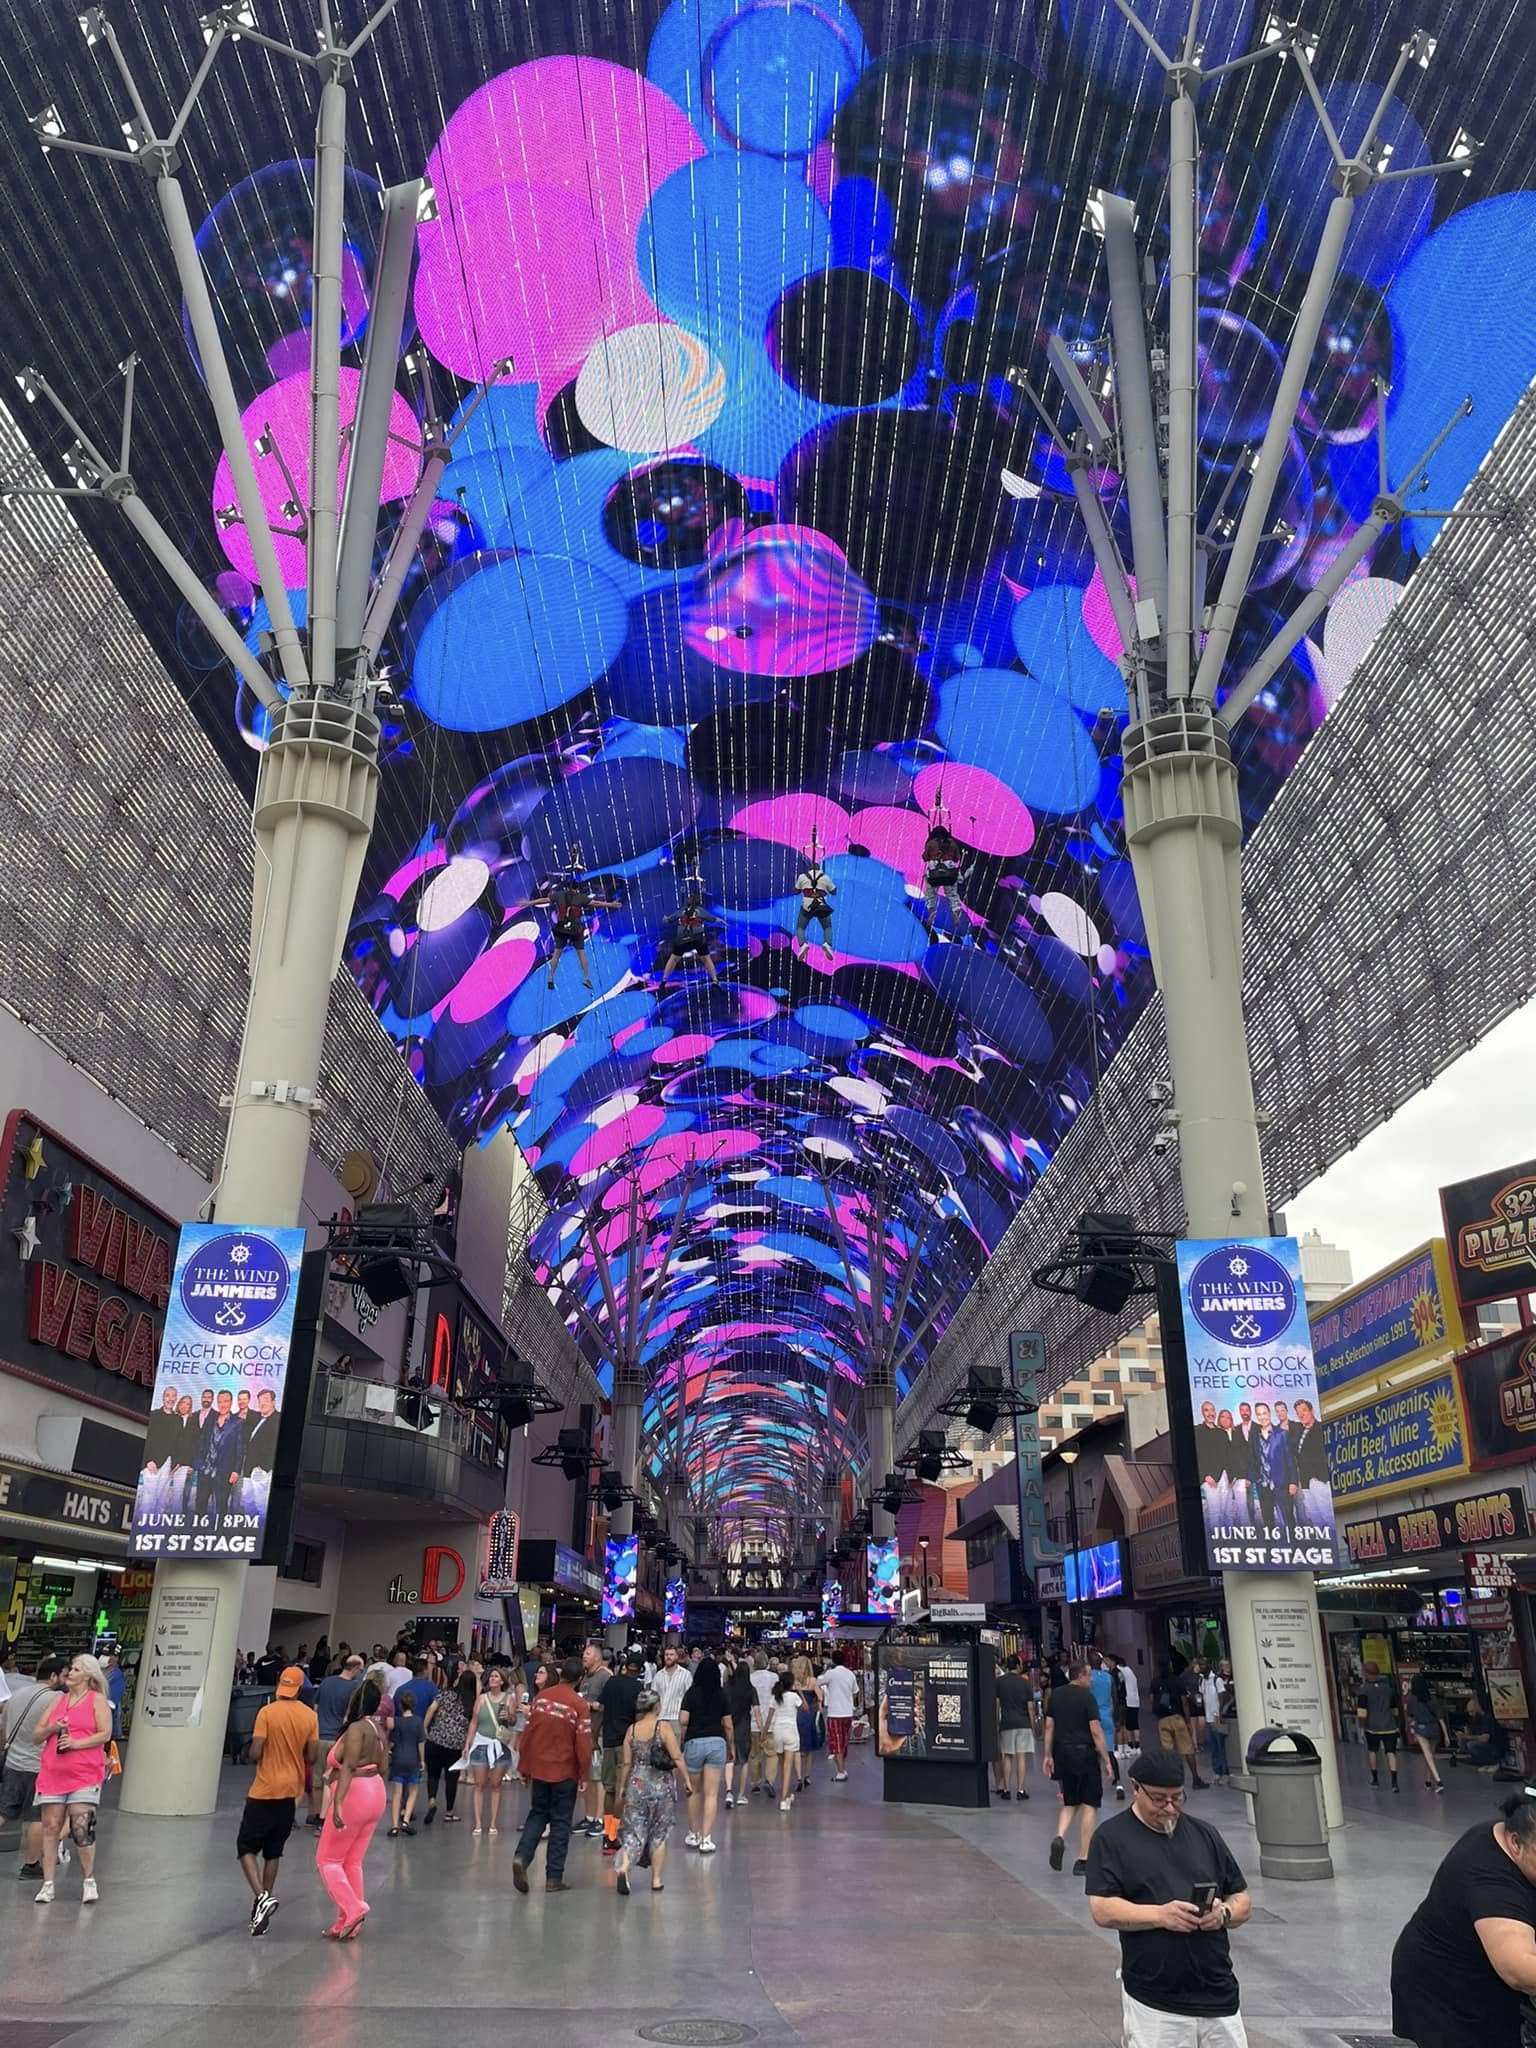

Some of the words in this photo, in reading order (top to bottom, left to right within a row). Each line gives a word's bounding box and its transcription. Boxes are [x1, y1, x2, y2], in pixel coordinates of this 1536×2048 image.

[1505, 1189, 1536, 1218] 32
[72, 1183, 170, 1311] VIVA
[194, 1267, 228, 1281] THE
[234, 1269, 280, 1283] WIND
[190, 1284, 277, 1300] JAMMERS
[1199, 1282, 1234, 1295] THE
[1237, 1281, 1284, 1294] WIND
[1343, 1259, 1432, 1338] SUPERMART
[1201, 1297, 1286, 1312] JAMMERS
[32, 1259, 157, 1387] VEGA
[169, 1343, 227, 1359] YACHT
[232, 1344, 284, 1360] ROCK
[1330, 1354, 1344, 1371] Best
[1345, 1342, 1373, 1365] Selection
[1374, 1331, 1391, 1350] since
[1391, 1319, 1408, 1341] 1991
[162, 1360, 200, 1375] FREE
[205, 1361, 284, 1376] CONCERT
[1194, 1356, 1251, 1373] YACHT
[1257, 1356, 1308, 1371] ROCK
[1193, 1375, 1230, 1388] FREE
[1235, 1373, 1312, 1388] CONCERT
[1333, 1414, 1373, 1442] T-shirts,
[1017, 1369, 1042, 1528] PRTAL
[1335, 1440, 1358, 1465] Cold
[1361, 1436, 1387, 1458] Beer,
[1390, 1421, 1419, 1448] Wine
[1377, 1441, 1444, 1478] Accessories
[63, 1491, 111, 1524] HATS
[138, 1513, 186, 1527] JUNE
[192, 1514, 209, 1528] 16
[223, 1514, 260, 1529] 8PM
[1347, 1520, 1387, 1561] PIZZA
[1397, 1509, 1441, 1552] BEER
[1455, 1493, 1515, 1544] SHOTS
[135, 1534, 165, 1551] 1ST
[167, 1535, 190, 1551] ST
[193, 1535, 257, 1552] STAGE
[1211, 1526, 1257, 1540] JUNE
[1263, 1526, 1281, 1540] 16
[1294, 1526, 1332, 1541] 8PM
[1213, 1547, 1242, 1563] 1ST
[1245, 1547, 1267, 1564] ST
[1270, 1547, 1333, 1564] STAGE
[389, 1575, 418, 1604] the
[422, 1546, 465, 1604] D
